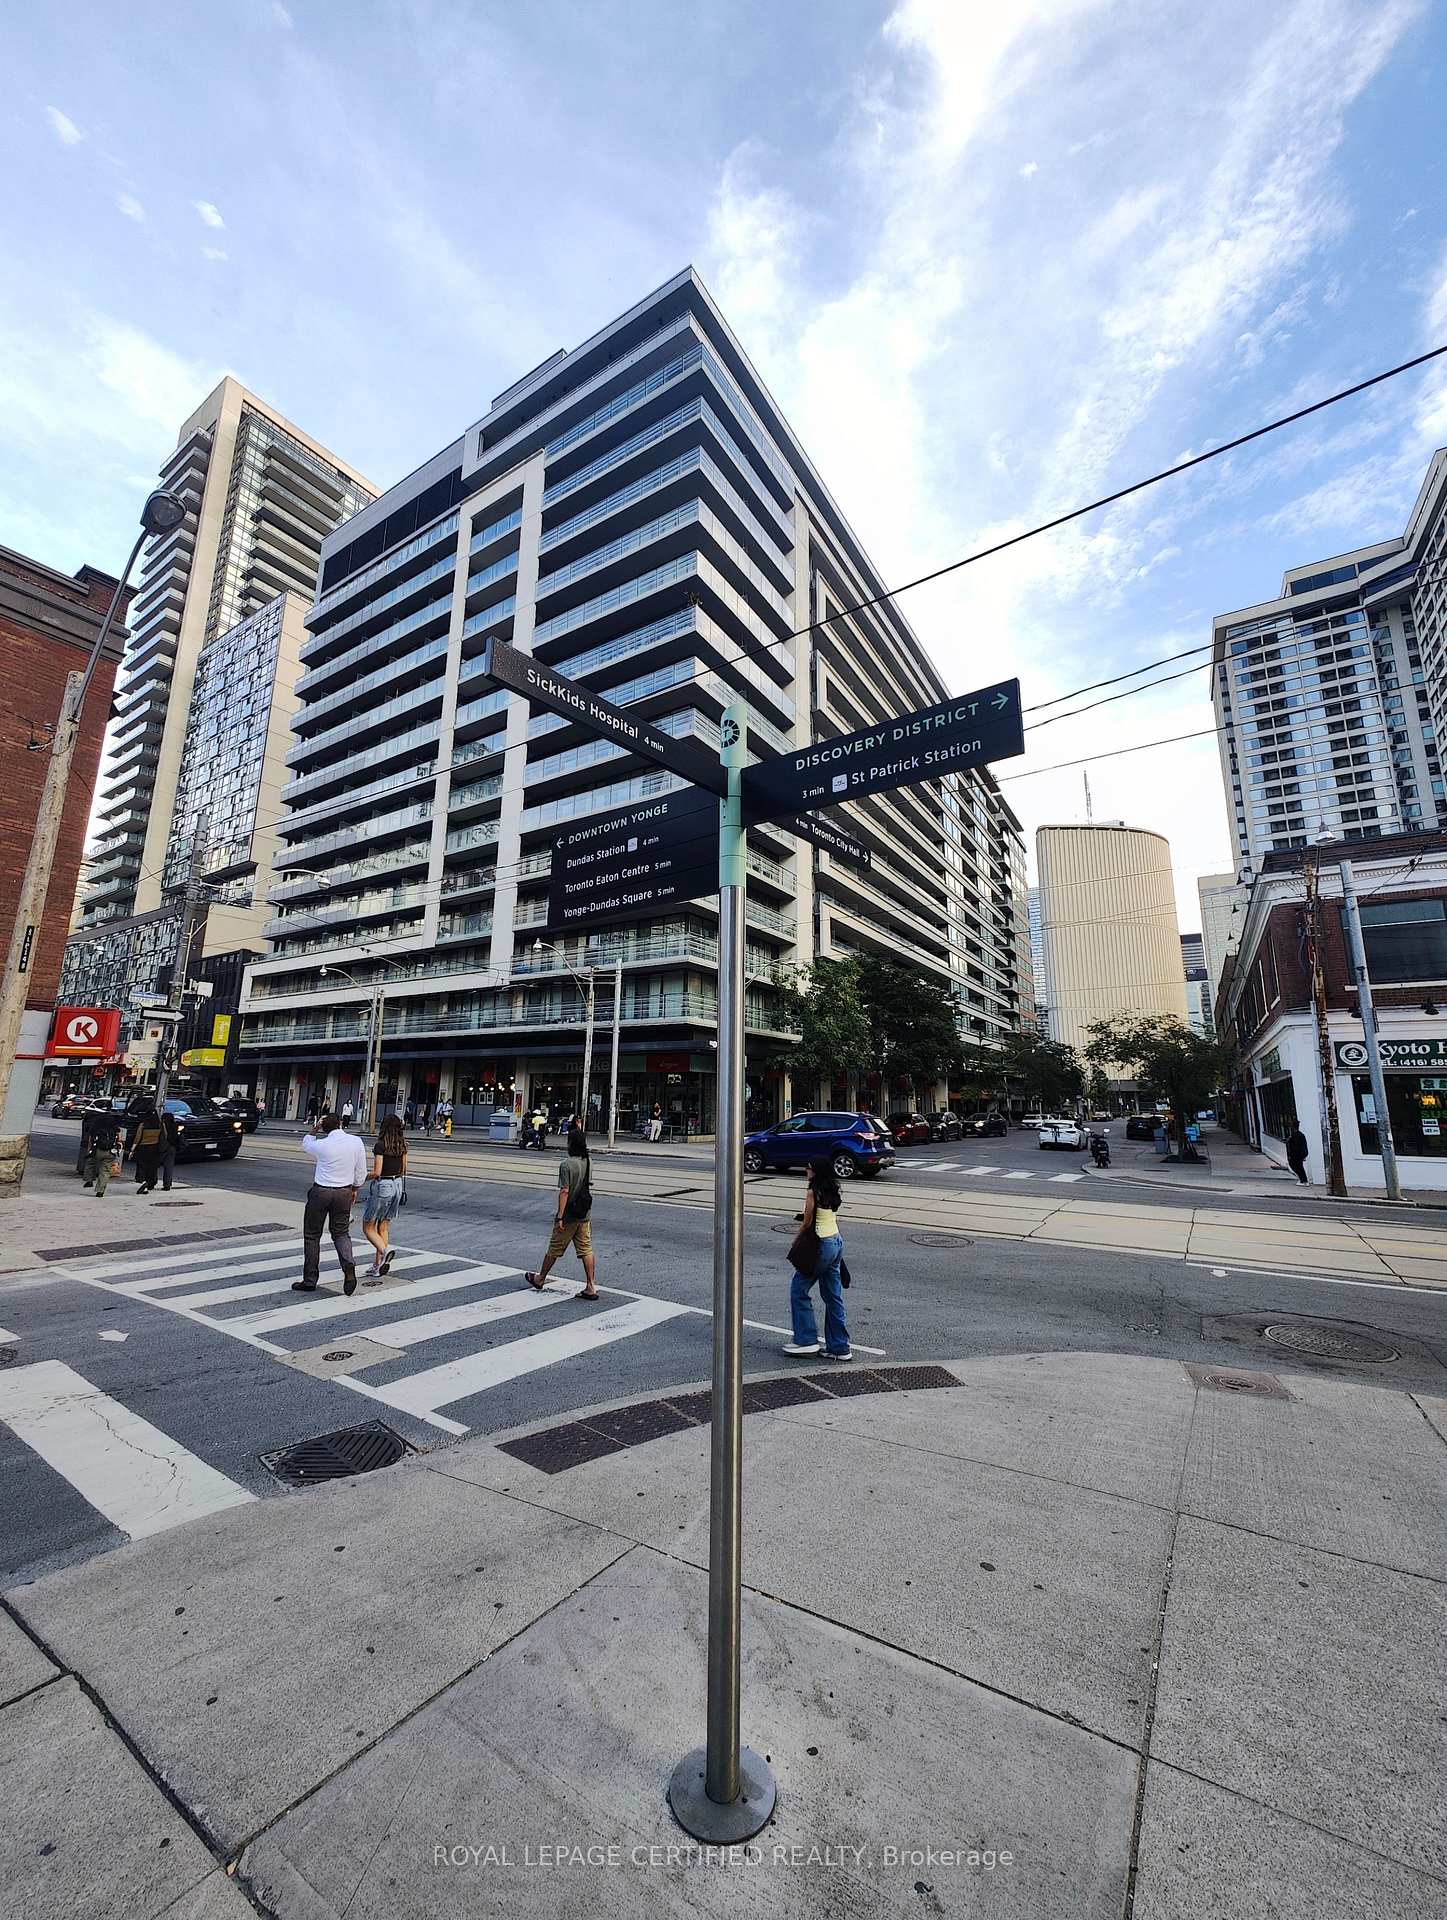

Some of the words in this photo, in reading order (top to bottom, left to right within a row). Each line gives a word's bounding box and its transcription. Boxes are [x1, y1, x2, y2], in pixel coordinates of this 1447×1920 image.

[527, 669, 586, 711] SickKids
[590, 703, 639, 739] Hospital
[644, 736, 650, 746] 4
[650, 739, 664, 753] min
[795, 733, 886, 771] DISCOVERY
[893, 702, 979, 741] DISTRICT
[802, 790, 809, 799] 3
[809, 786, 825, 797] min
[851, 772, 865, 785] St
[870, 756, 920, 780] Patrick
[924, 739, 982, 765] Station
[568, 817, 628, 845] DOWNTOWN
[631, 803, 668, 824] YONGE
[811, 823, 835, 844] Toronto
[836, 838, 848, 852] City
[848, 844, 860, 857] Hall
[566, 853, 595, 869] Dundas
[596, 843, 626, 860] Station
[642, 838, 648, 846] 4
[647, 836, 660, 845] min
[565, 879, 594, 894] Toronto
[596, 873, 619, 886] Eaton
[621, 864, 650, 879] Centre
[654, 862, 659, 870] 5
[659, 859, 672, 869] min
[563, 897, 620, 919] Yonge-Dundas
[622, 890, 653, 905] Square
[657, 888, 662, 897] 5
[662, 885, 675, 895] min
[75, 1022, 93, 1040] K
[566, 1057, 612, 1071] make
[1378, 1042, 1431, 1061] Kyoto
[1400, 1058, 1428, 1066] (416)
